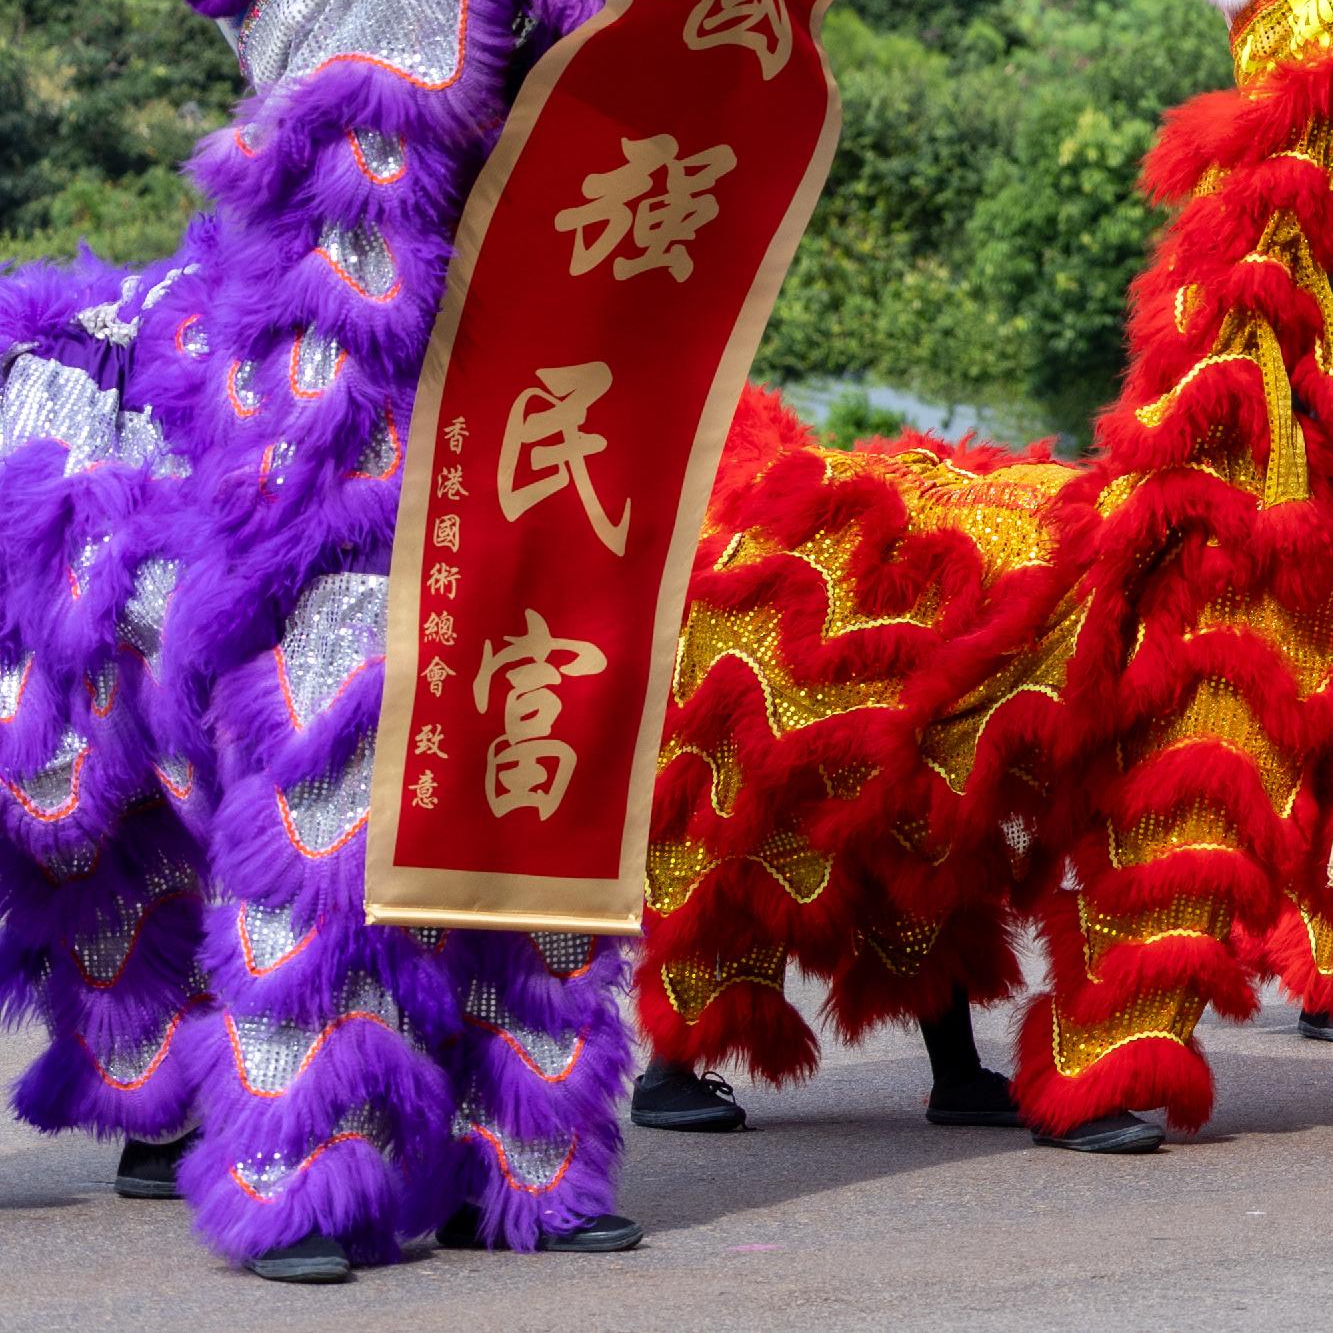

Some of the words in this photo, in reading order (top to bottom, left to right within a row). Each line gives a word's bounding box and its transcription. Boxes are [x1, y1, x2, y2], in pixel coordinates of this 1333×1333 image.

[420, 416, 470, 698] 香港國術總會
[408, 723, 449, 810] 致意
